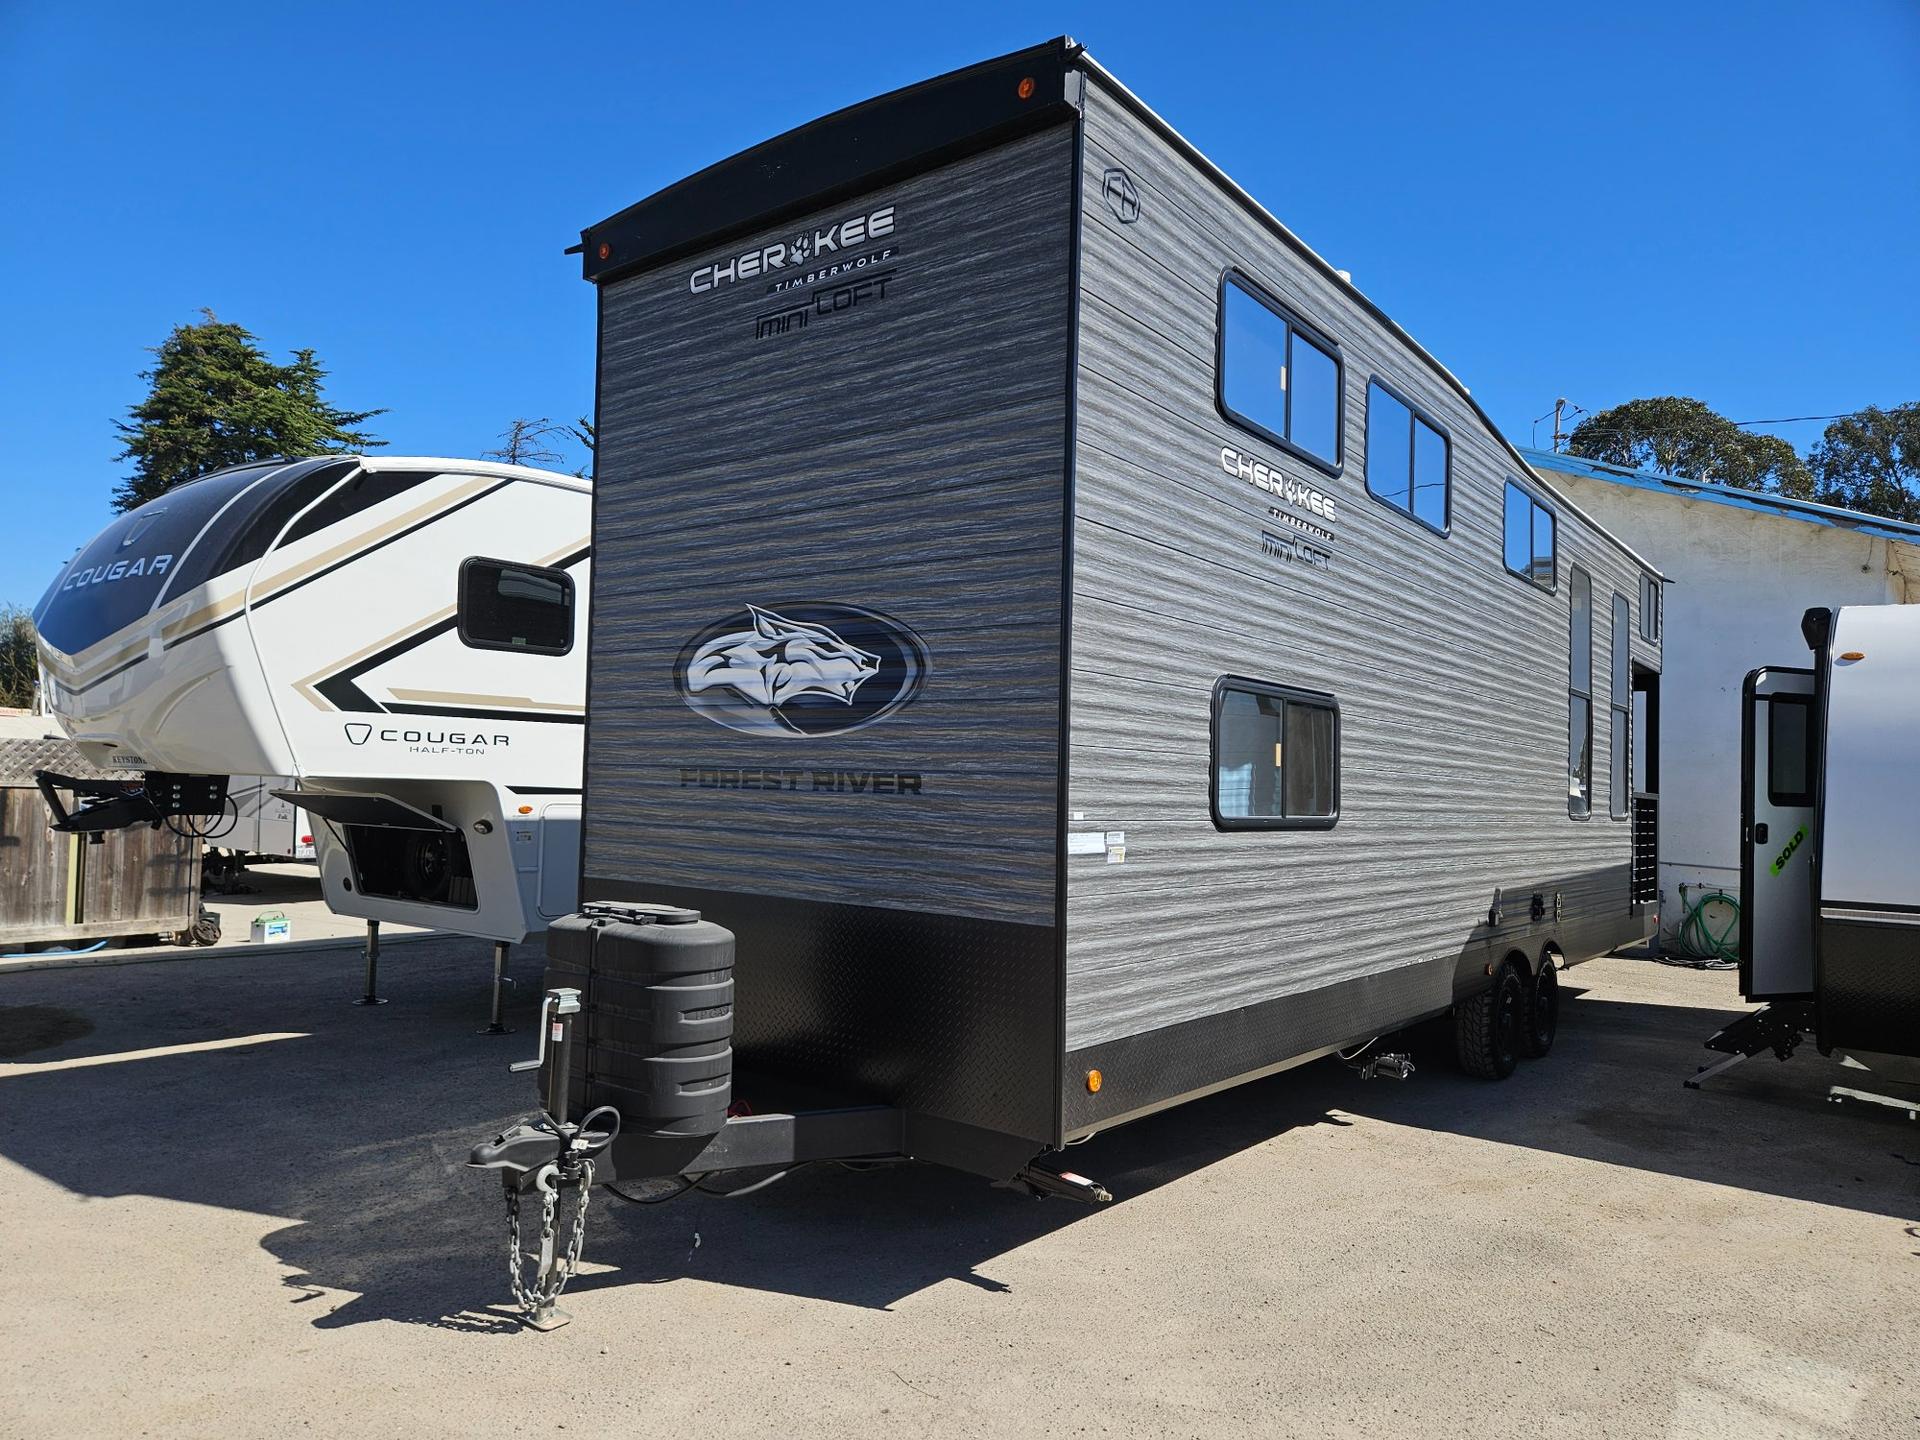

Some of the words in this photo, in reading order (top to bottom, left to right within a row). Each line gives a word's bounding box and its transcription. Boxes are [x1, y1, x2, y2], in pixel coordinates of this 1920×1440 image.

[774, 249, 892, 292] TIMBERWOLF
[1272, 509, 1333, 541] TIMBERWOLF
[63, 555, 173, 591] COUGAR
[380, 730, 510, 746] COUGAR
[409, 746, 485, 755] HALF-TON
[679, 768, 803, 790] FOREST
[811, 771, 922, 794] RIVER
[1775, 831, 1804, 870] SOLD
